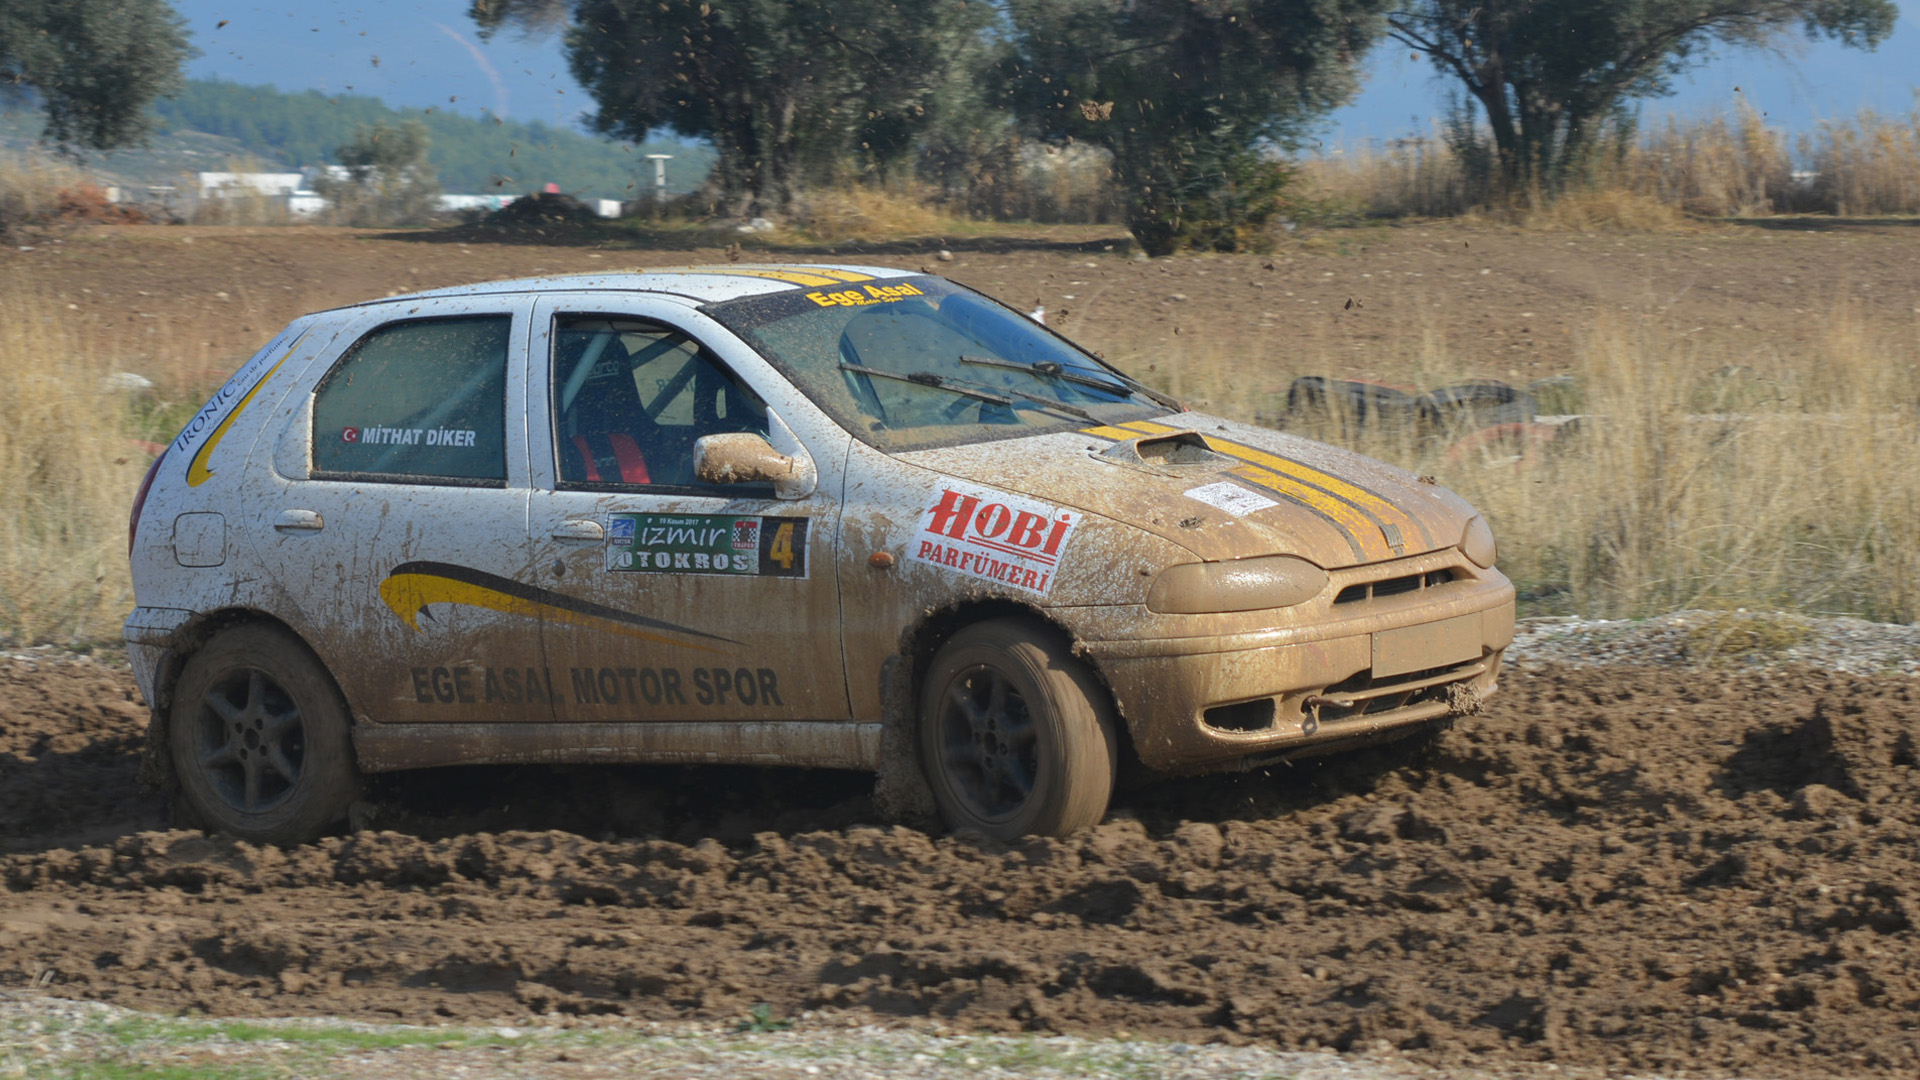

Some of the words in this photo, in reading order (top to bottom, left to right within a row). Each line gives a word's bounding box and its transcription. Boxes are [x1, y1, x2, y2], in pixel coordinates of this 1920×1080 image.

[806, 289, 865, 307] Ege
[863, 282, 925, 299] Asal
[362, 424, 423, 445] MİTHAT
[426, 425, 476, 447] DİKER
[685, 518, 699, 526] 2017
[925, 489, 1072, 557] HOBİ
[618, 551, 749, 571] OTOKROS
[770, 523, 794, 569] 4
[917, 540, 1050, 592] PARFÜMERİ
[411, 666, 476, 704] EGE
[485, 666, 566, 704] ASAL
[571, 667, 688, 705] MOTOR
[693, 666, 784, 707] SPOR
